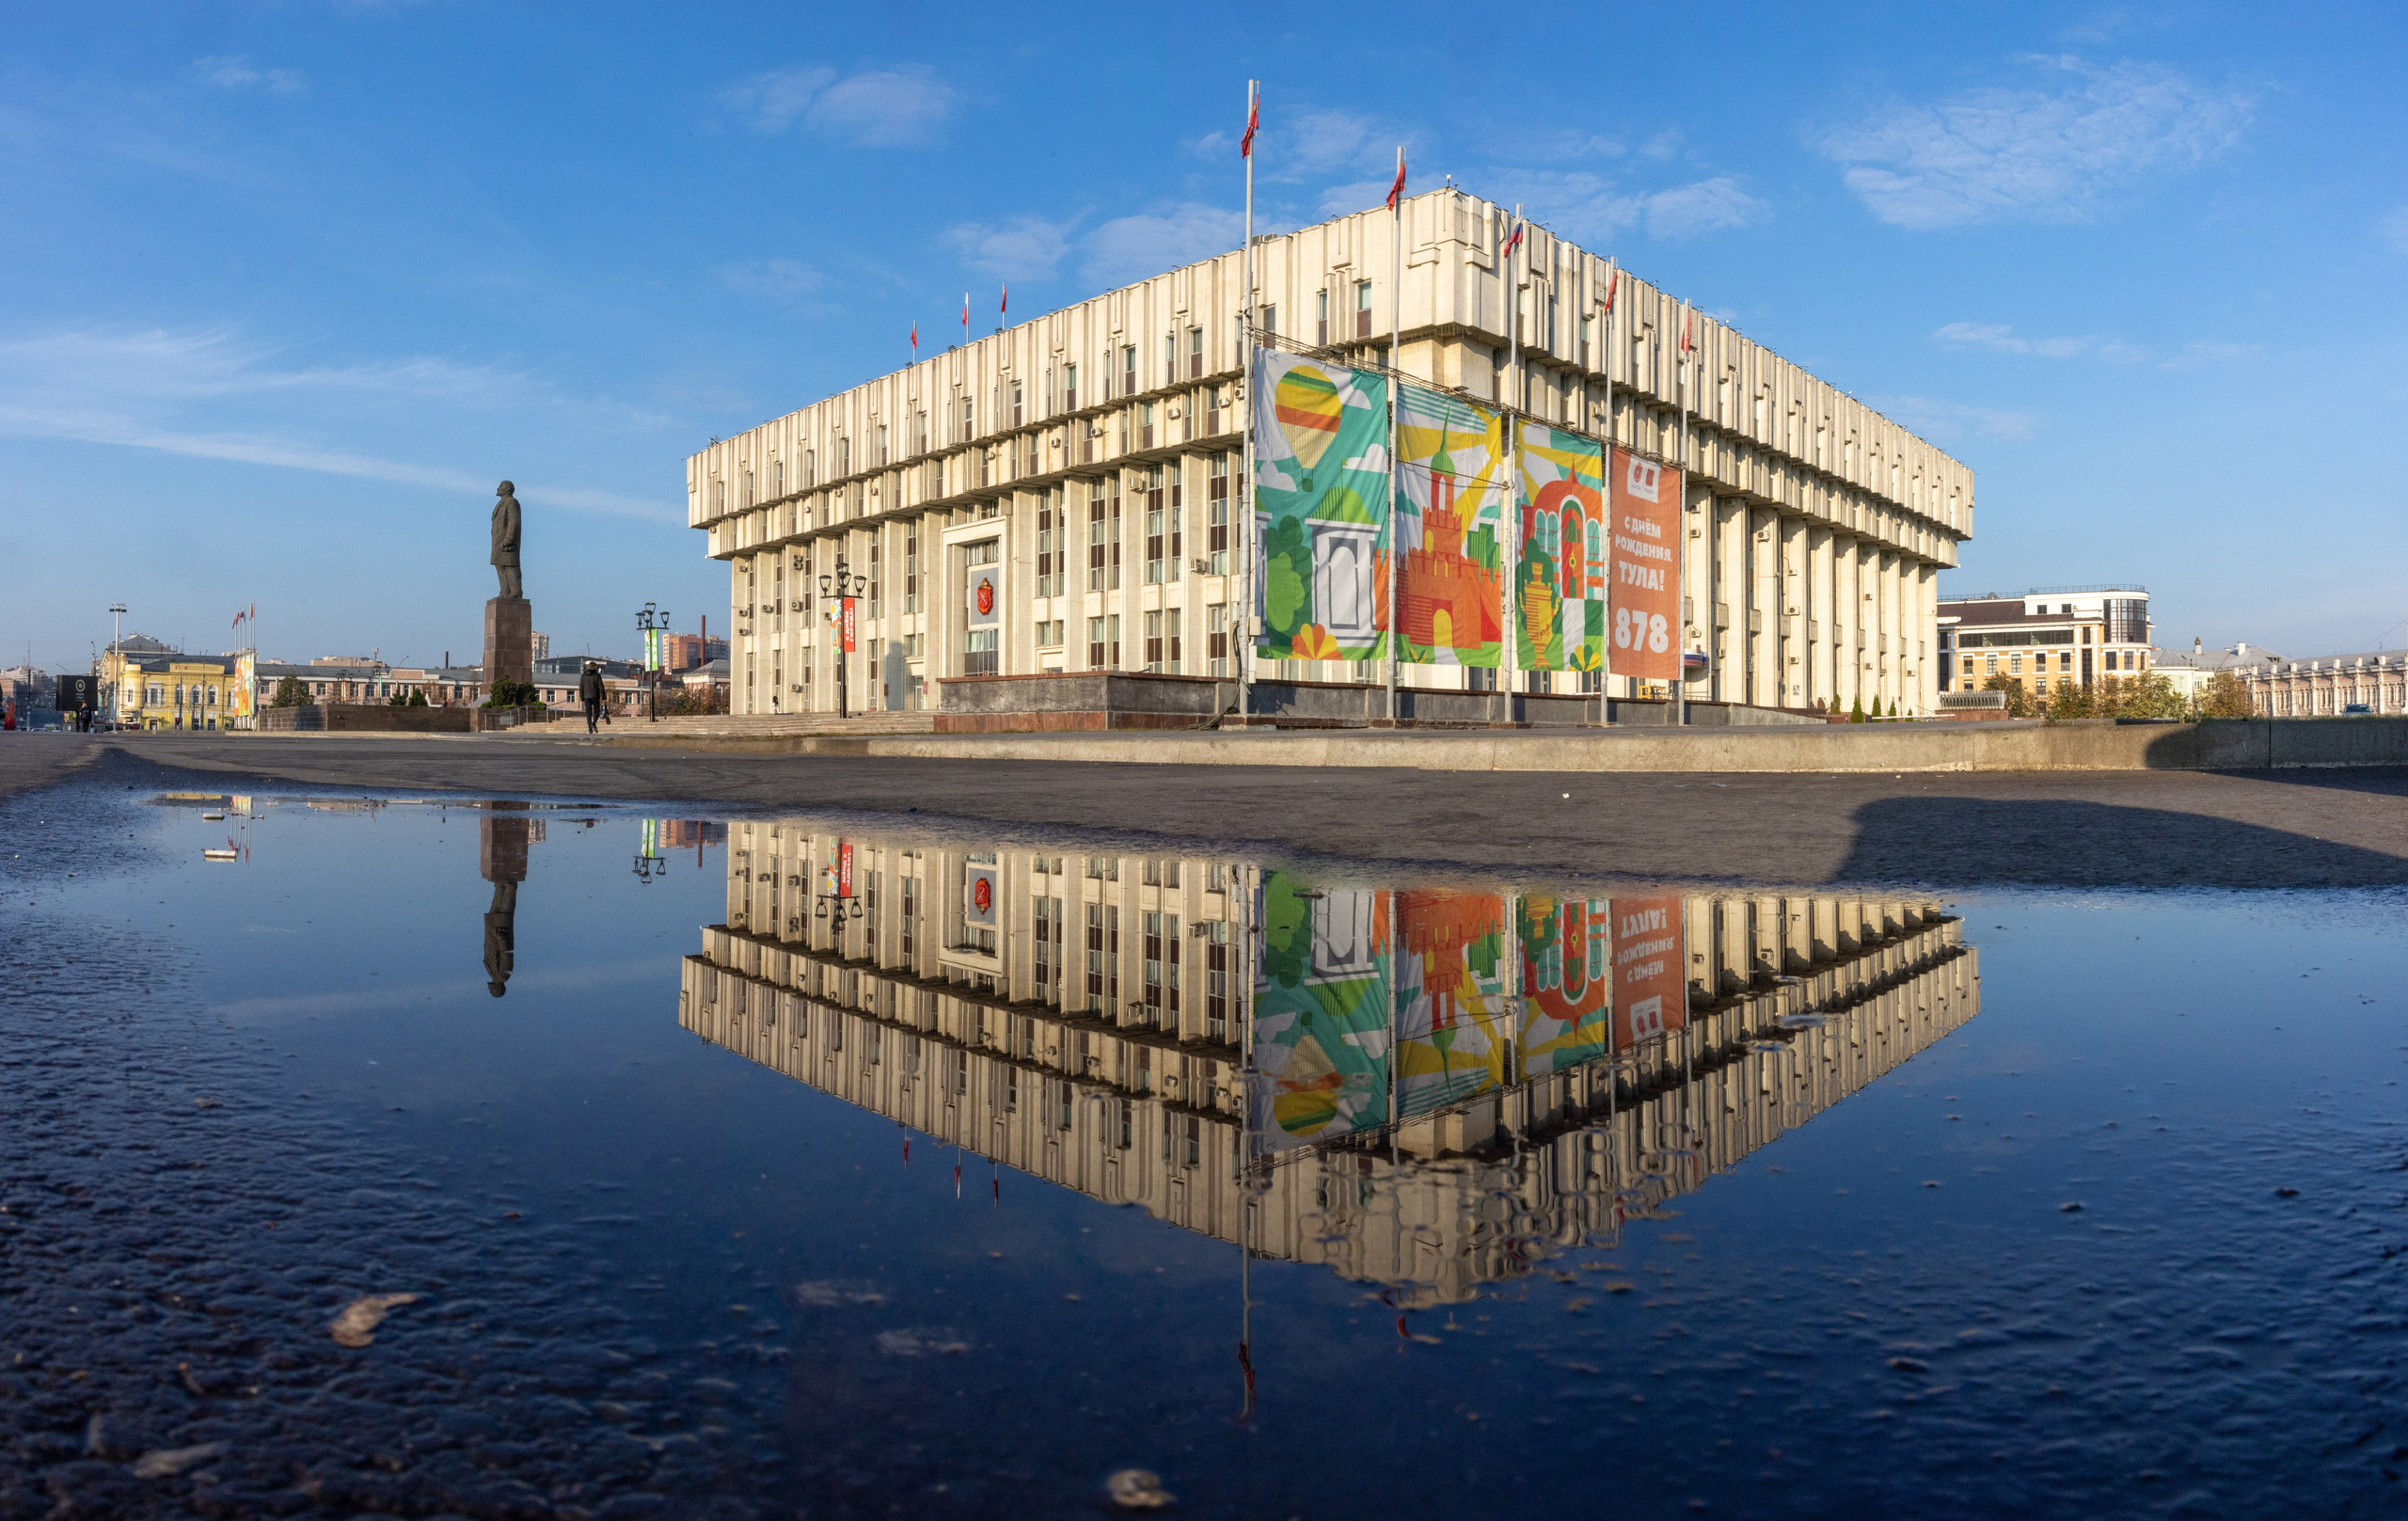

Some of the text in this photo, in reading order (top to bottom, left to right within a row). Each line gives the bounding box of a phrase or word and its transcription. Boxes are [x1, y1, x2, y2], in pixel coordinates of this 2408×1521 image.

[1624, 515, 1661, 539] С ДНЁМ
[1615, 533, 1673, 563] РОЖДЕНИЯ,
[1619, 560, 1665, 592] ТУЛА!
[1615, 607, 1670, 654] 878
